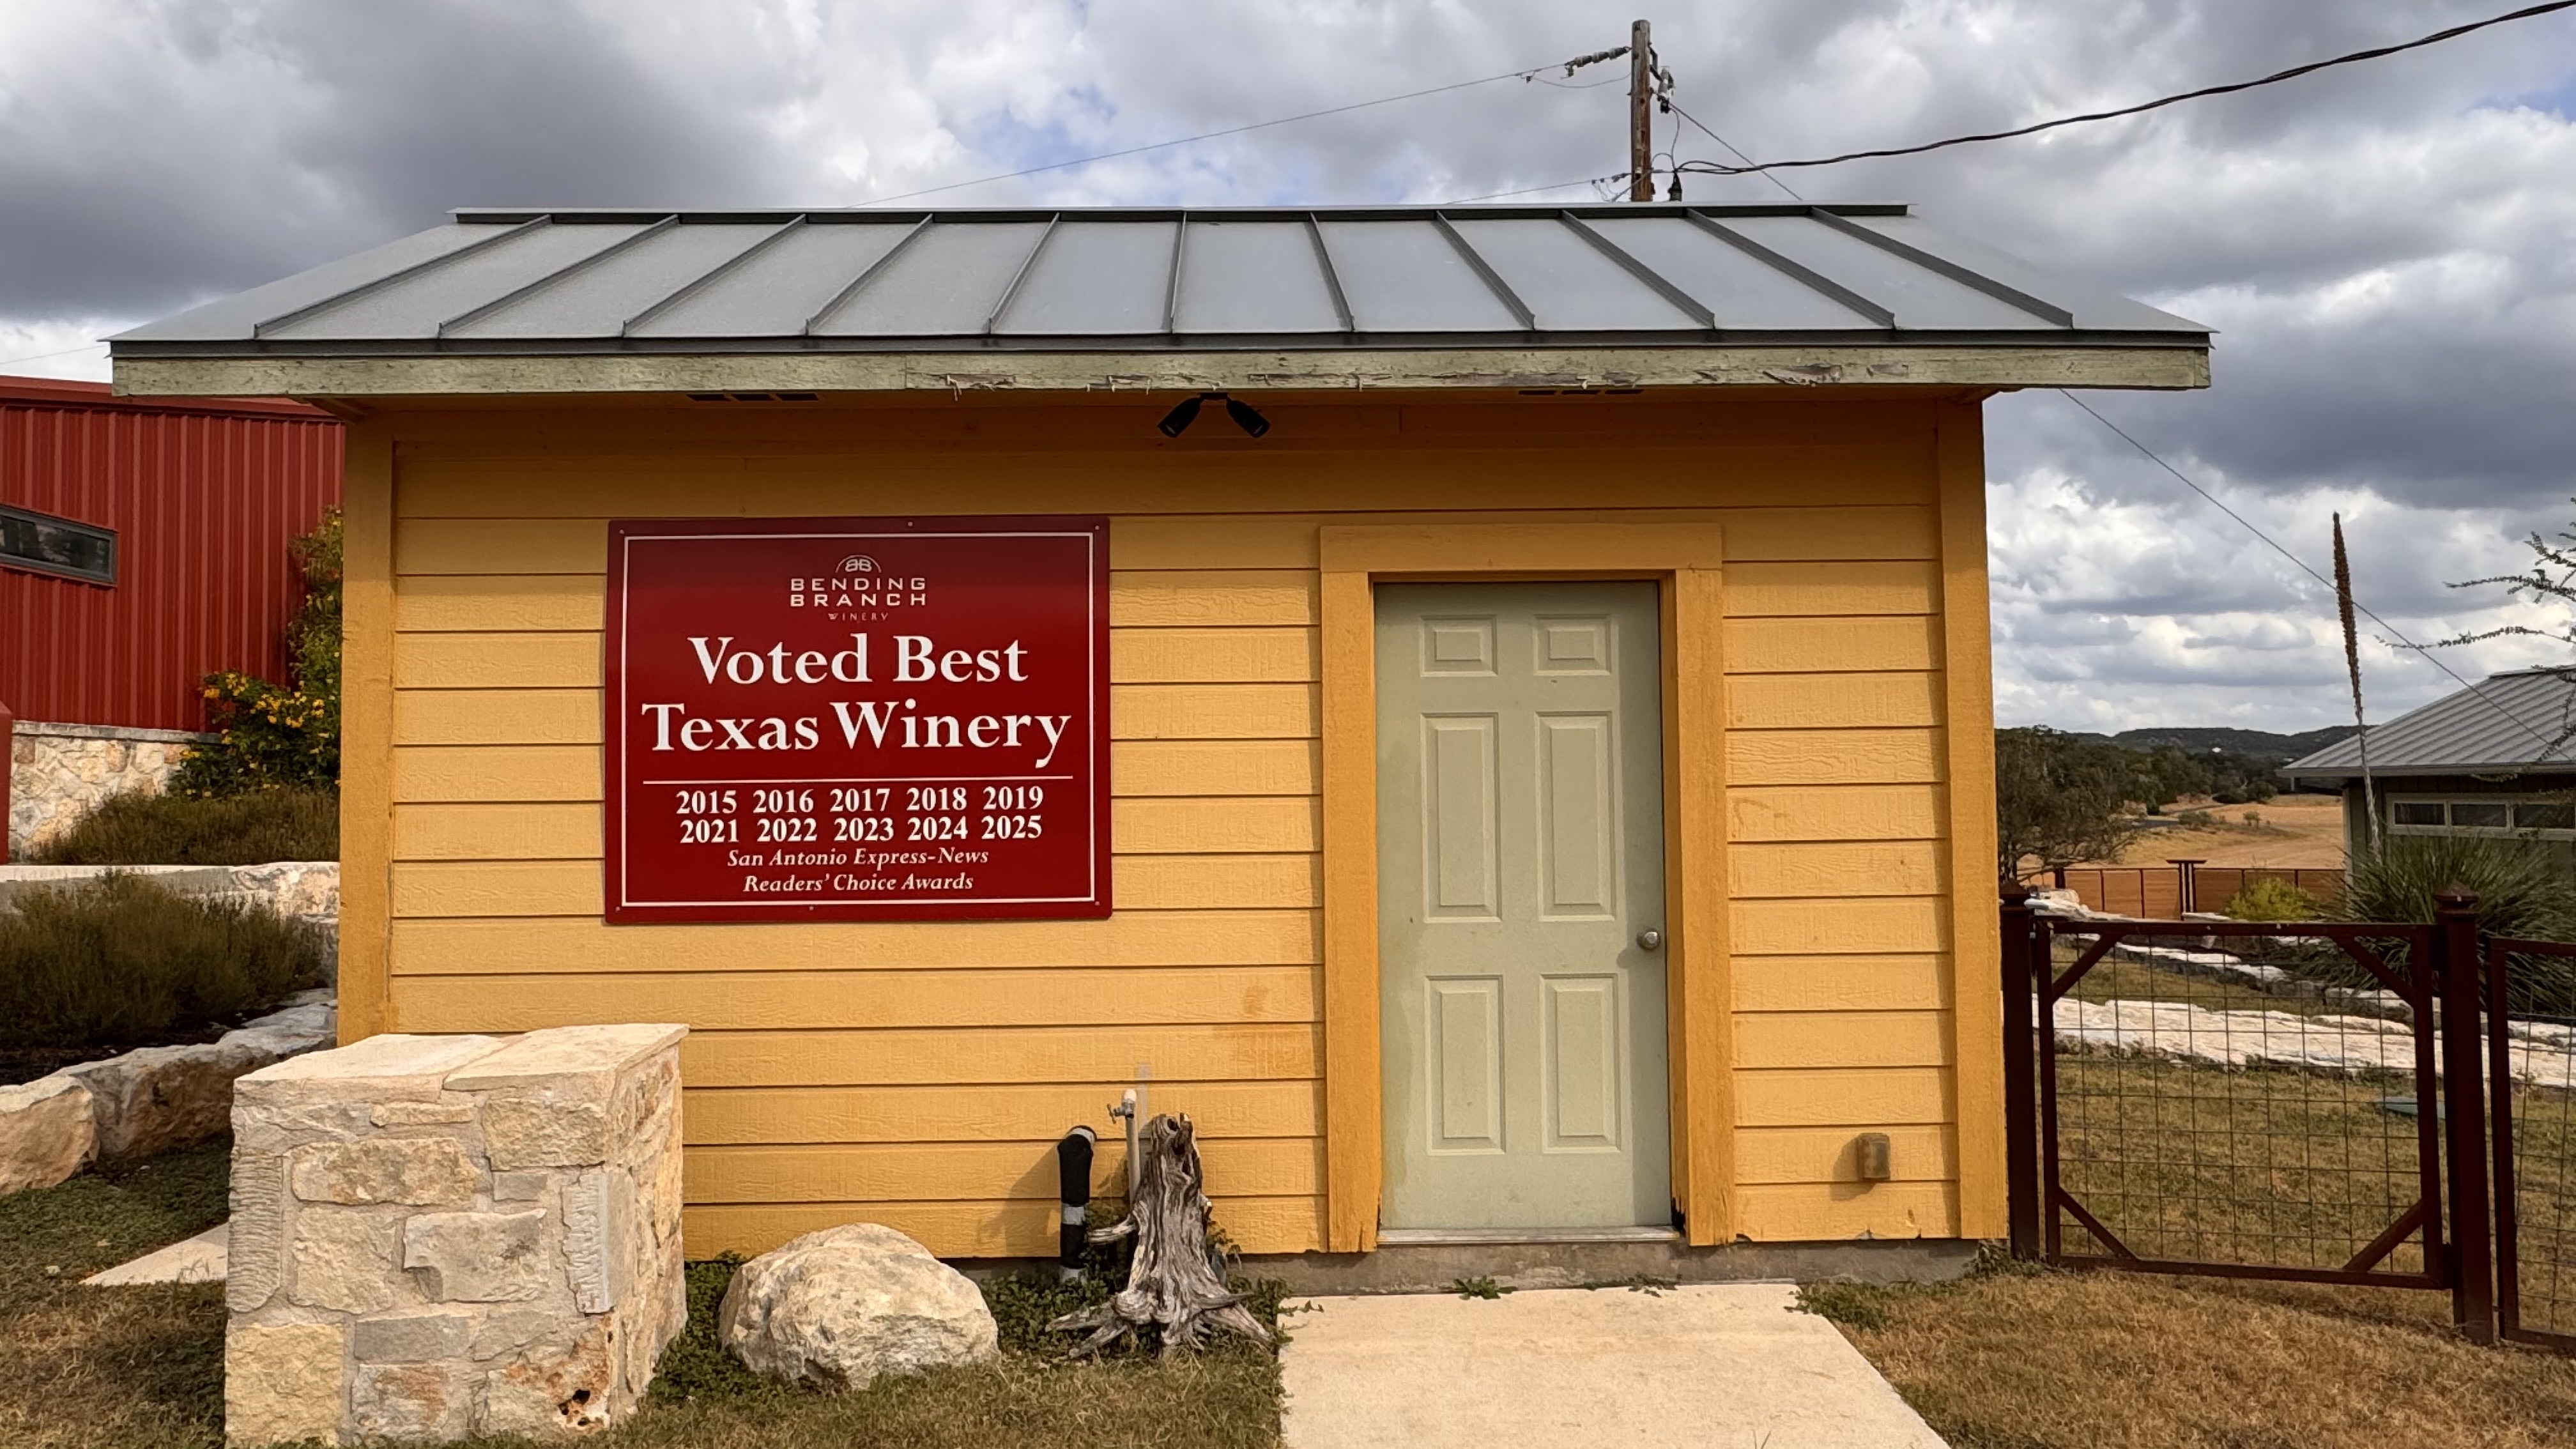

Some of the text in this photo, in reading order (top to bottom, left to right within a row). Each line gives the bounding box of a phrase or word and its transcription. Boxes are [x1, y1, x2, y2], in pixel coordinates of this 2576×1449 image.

[790, 577, 926, 592] BENDING
[790, 593, 926, 607] BRANCH
[828, 612, 888, 621] WINERY
[687, 632, 1029, 685] Voted Best
[641, 698, 1072, 769] Texas Winery
[676, 786, 1044, 815] 2015 2016 2017 2018 2019
[680, 815, 1042, 844] 2021 2022 2023 2024 2025
[727, 847, 989, 871] San Antonio Express-News
[742, 871, 974, 893] Readers' Choice Awards
